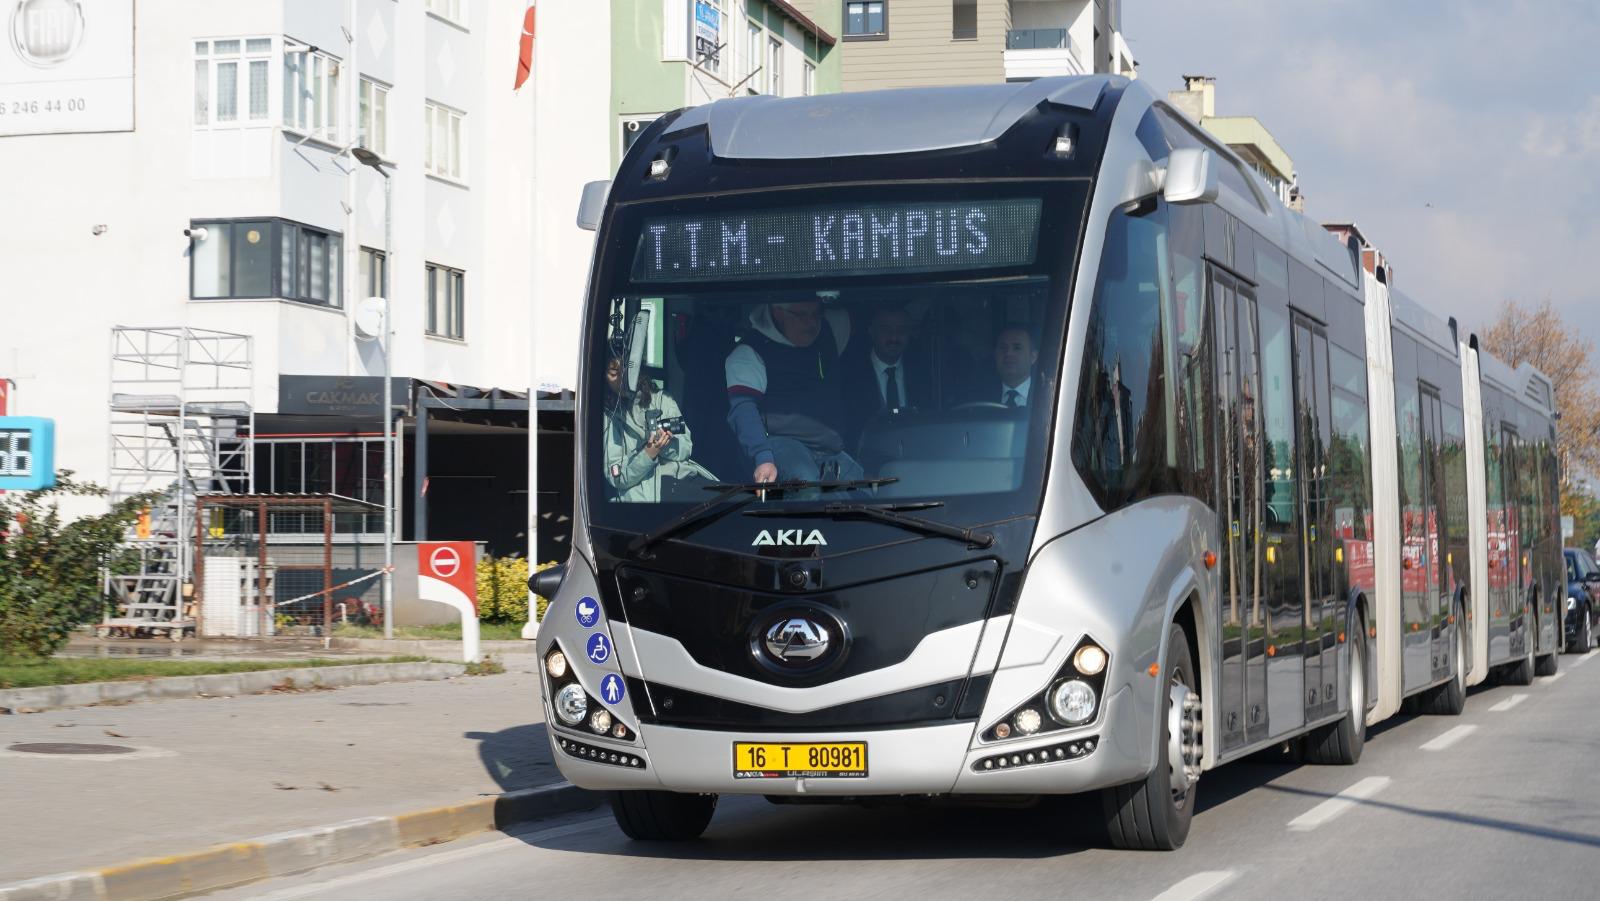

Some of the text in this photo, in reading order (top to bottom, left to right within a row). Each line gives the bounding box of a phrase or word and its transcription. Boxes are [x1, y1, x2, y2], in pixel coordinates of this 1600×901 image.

[12, 100, 39, 114] 246
[44, 99, 61, 112] 44
[67, 98, 86, 111] 00
[813, 208, 988, 261] KAMPUS
[751, 529, 828, 546] AKIA
[748, 747, 860, 768] 16 T 80981
